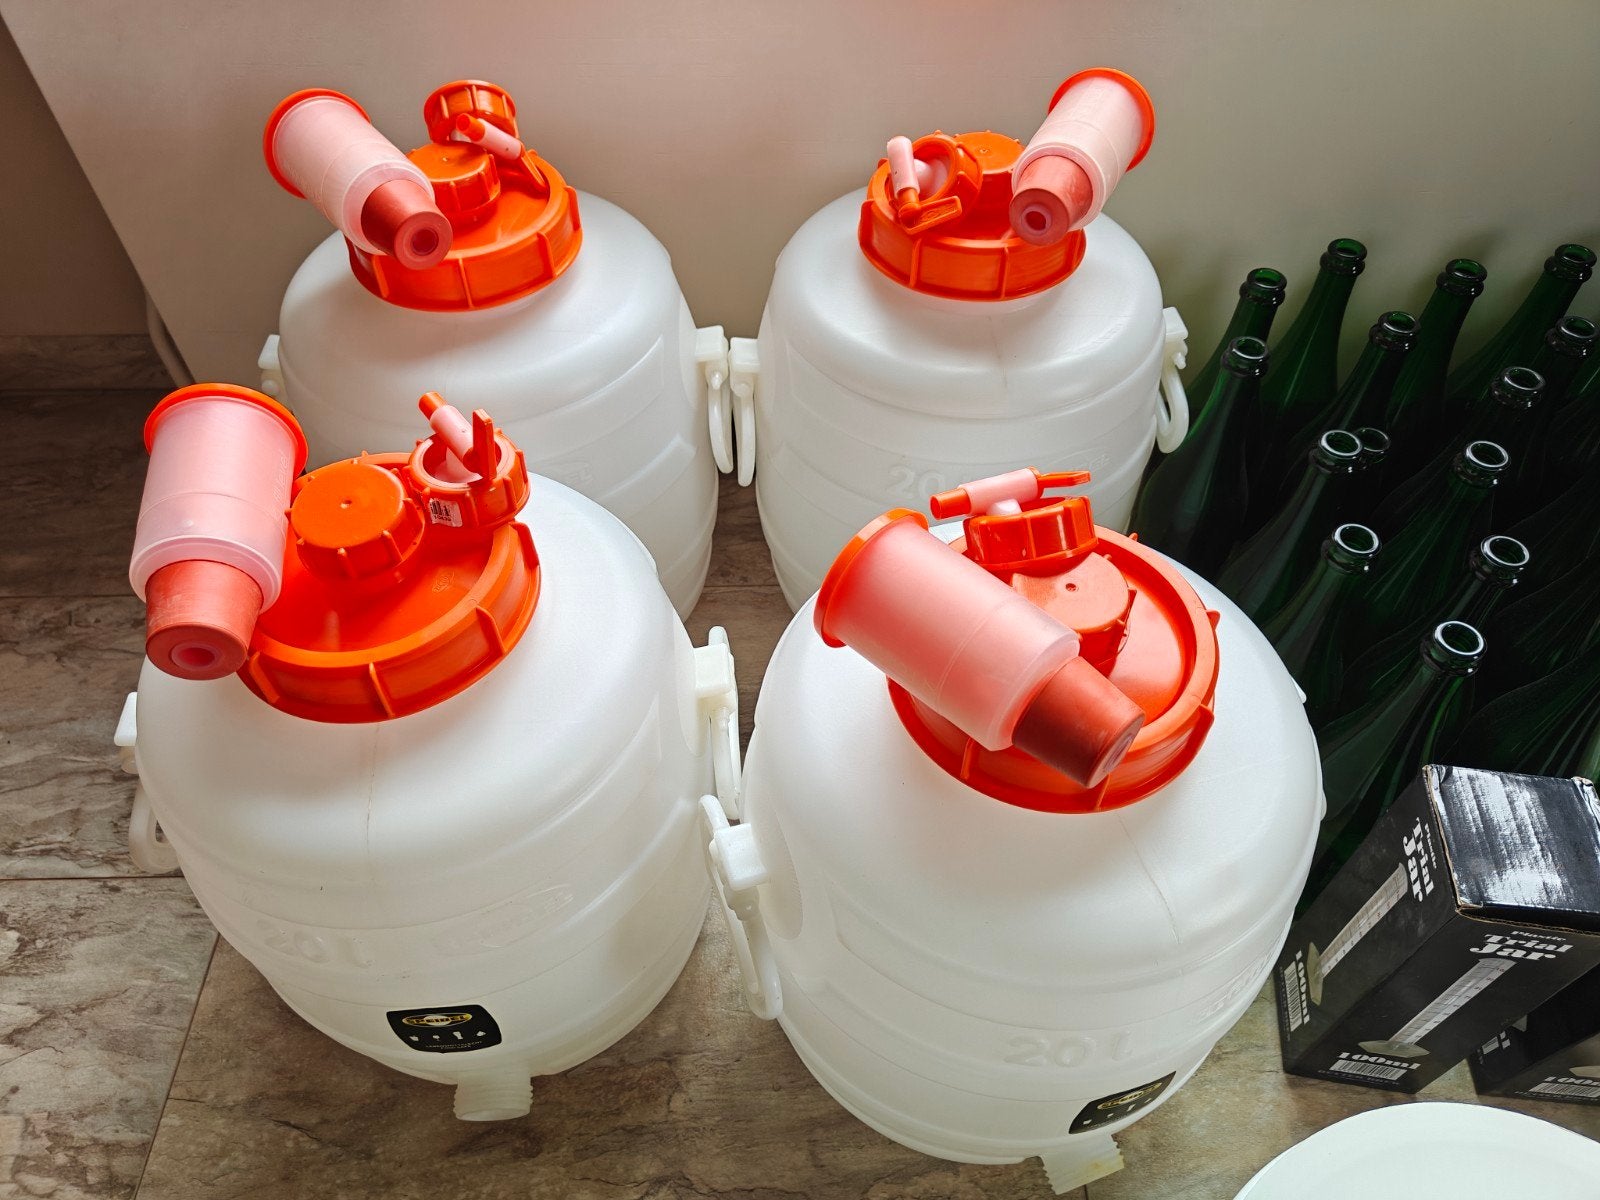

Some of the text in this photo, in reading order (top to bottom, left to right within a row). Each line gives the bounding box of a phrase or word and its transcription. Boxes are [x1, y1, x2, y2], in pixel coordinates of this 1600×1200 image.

[1403, 836, 1423, 902] Jar
[1413, 817, 1434, 896] Trial
[1469, 943, 1557, 961] Jar
[1484, 934, 1574, 953] Trial
[1296, 950, 1311, 1026] 100ml
[1337, 1052, 1421, 1069] 100ml
